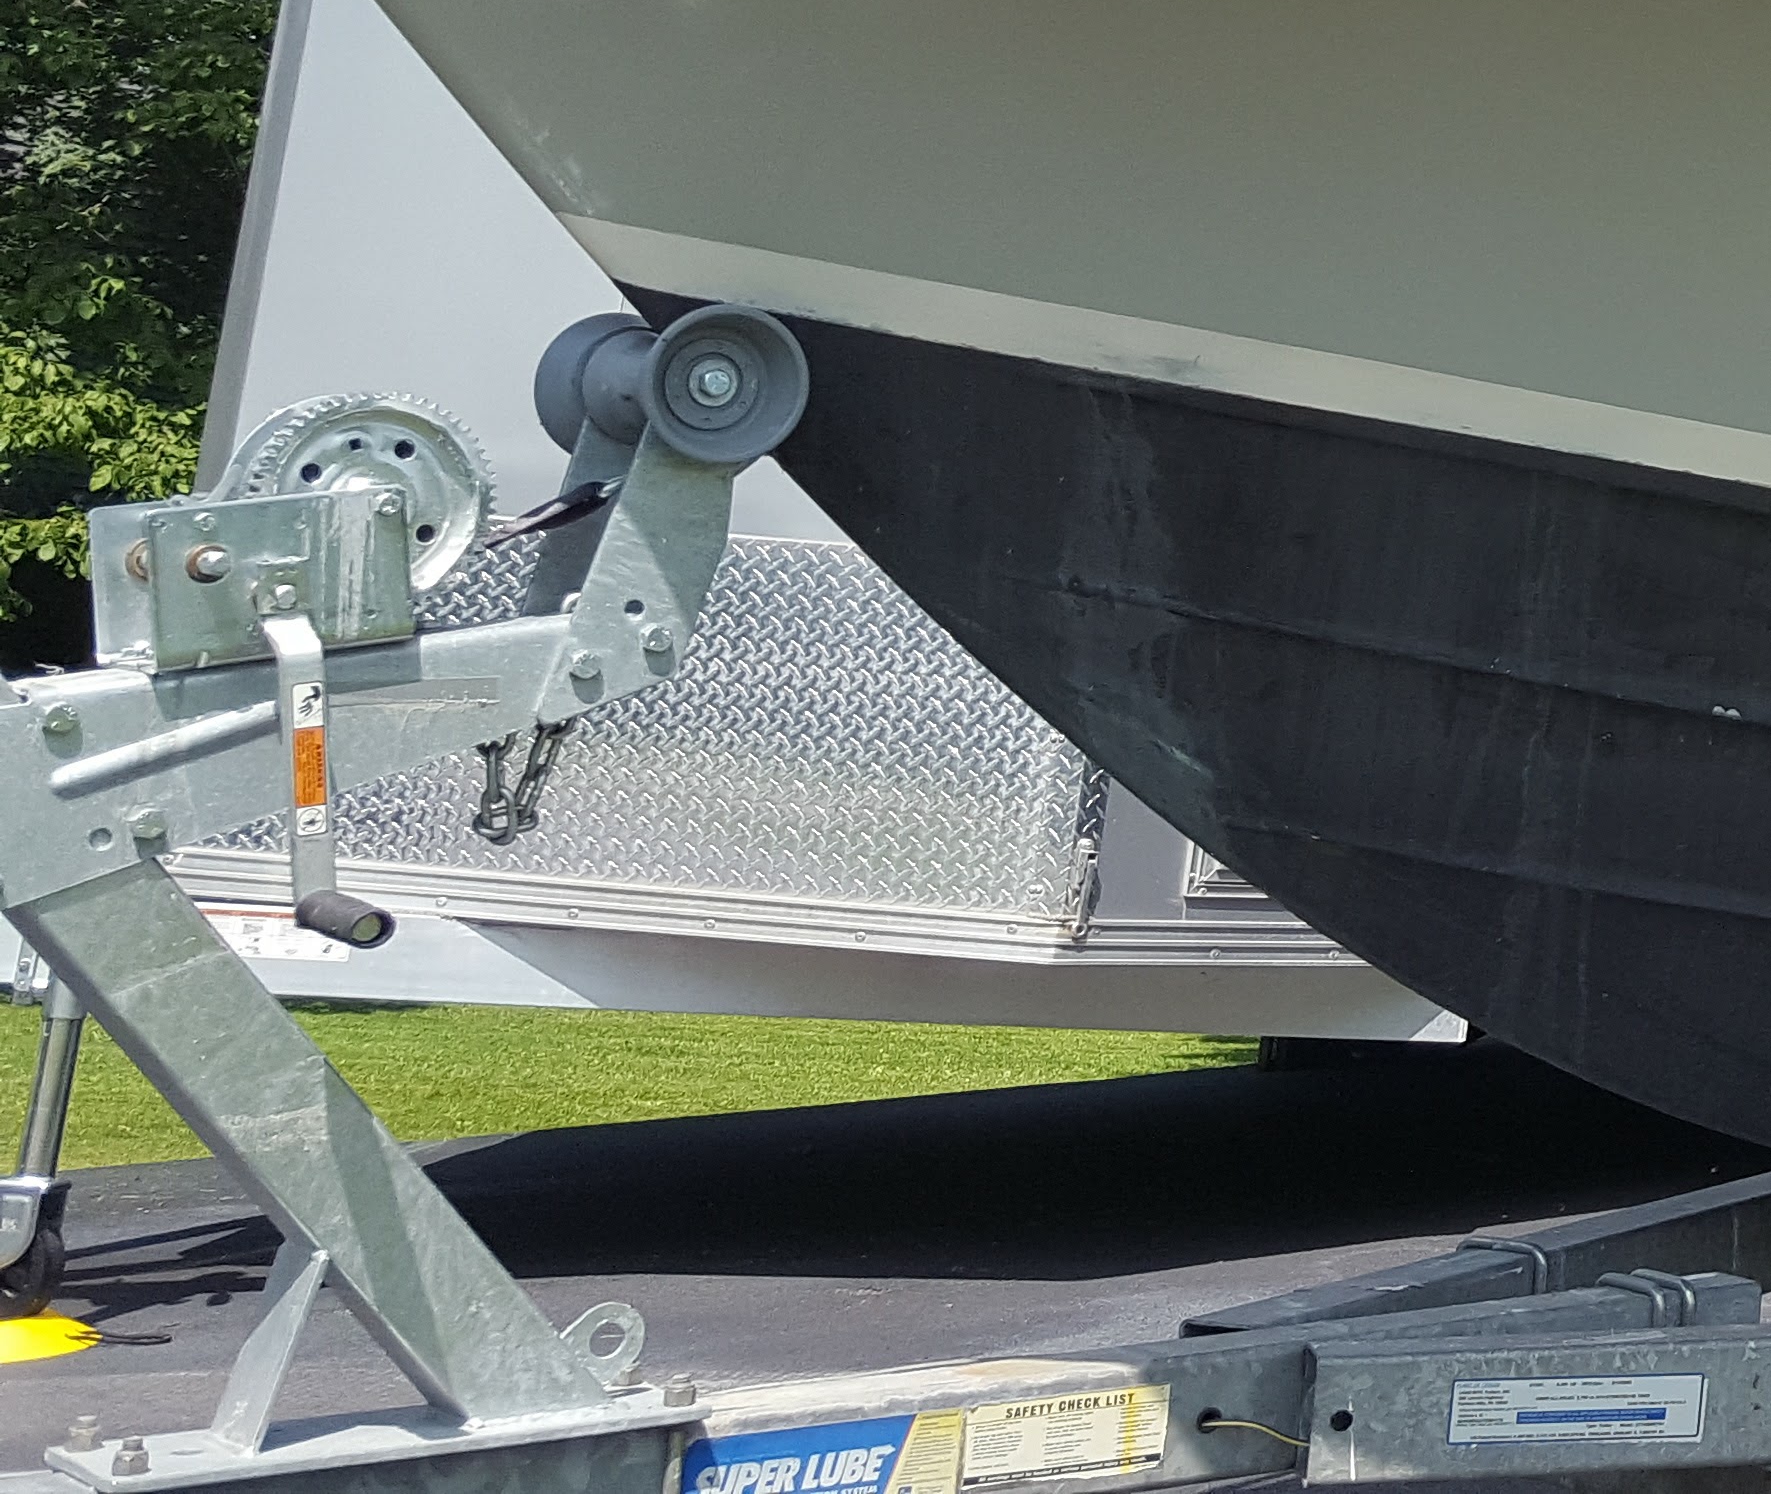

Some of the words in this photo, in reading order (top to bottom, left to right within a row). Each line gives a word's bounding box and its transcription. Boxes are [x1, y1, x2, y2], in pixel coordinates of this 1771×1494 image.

[1005, 1402, 1054, 1419] SAFETY
[1058, 1396, 1100, 1412] CHECK
[1105, 1392, 1135, 1406] LIST
[696, 1457, 800, 1494] SUPER
[801, 1444, 896, 1490] LUBE
